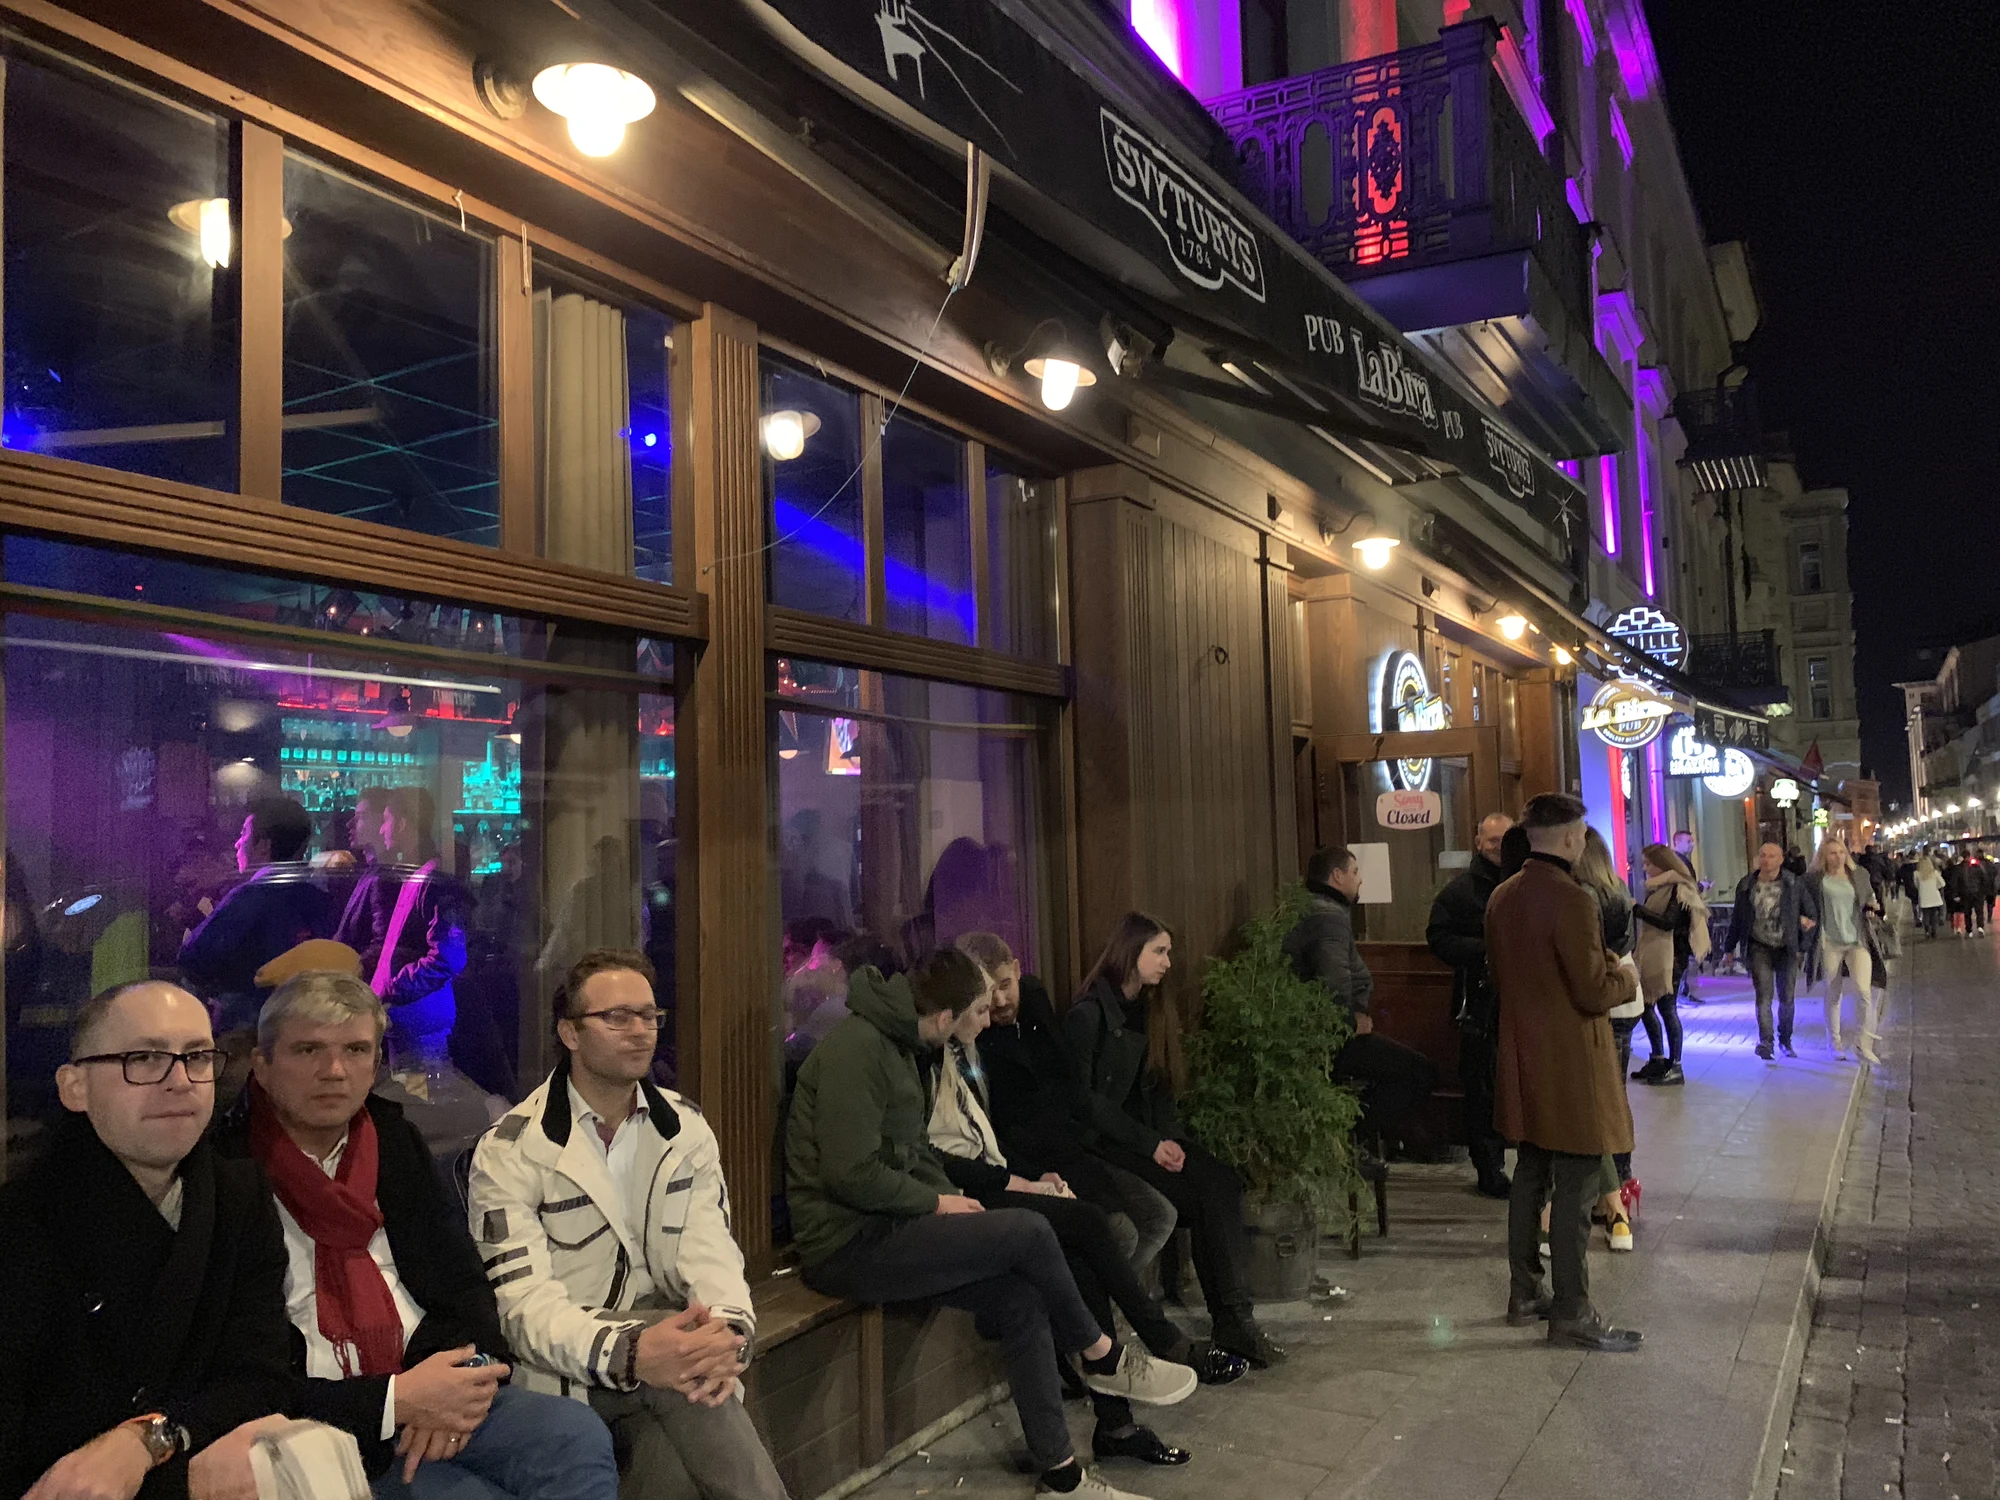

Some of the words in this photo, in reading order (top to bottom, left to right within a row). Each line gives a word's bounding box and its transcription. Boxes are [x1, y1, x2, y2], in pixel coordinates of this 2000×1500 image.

[1113, 125, 1256, 282] ŠVYTURYS
[1181, 233, 1212, 269] 1784
[1304, 314, 1345, 354] PUB
[1442, 410, 1465, 440] PUB
[1618, 720, 1642, 733] PUB
[1393, 793, 1424, 810] Sorry
[1387, 810, 1430, 825] Closed
